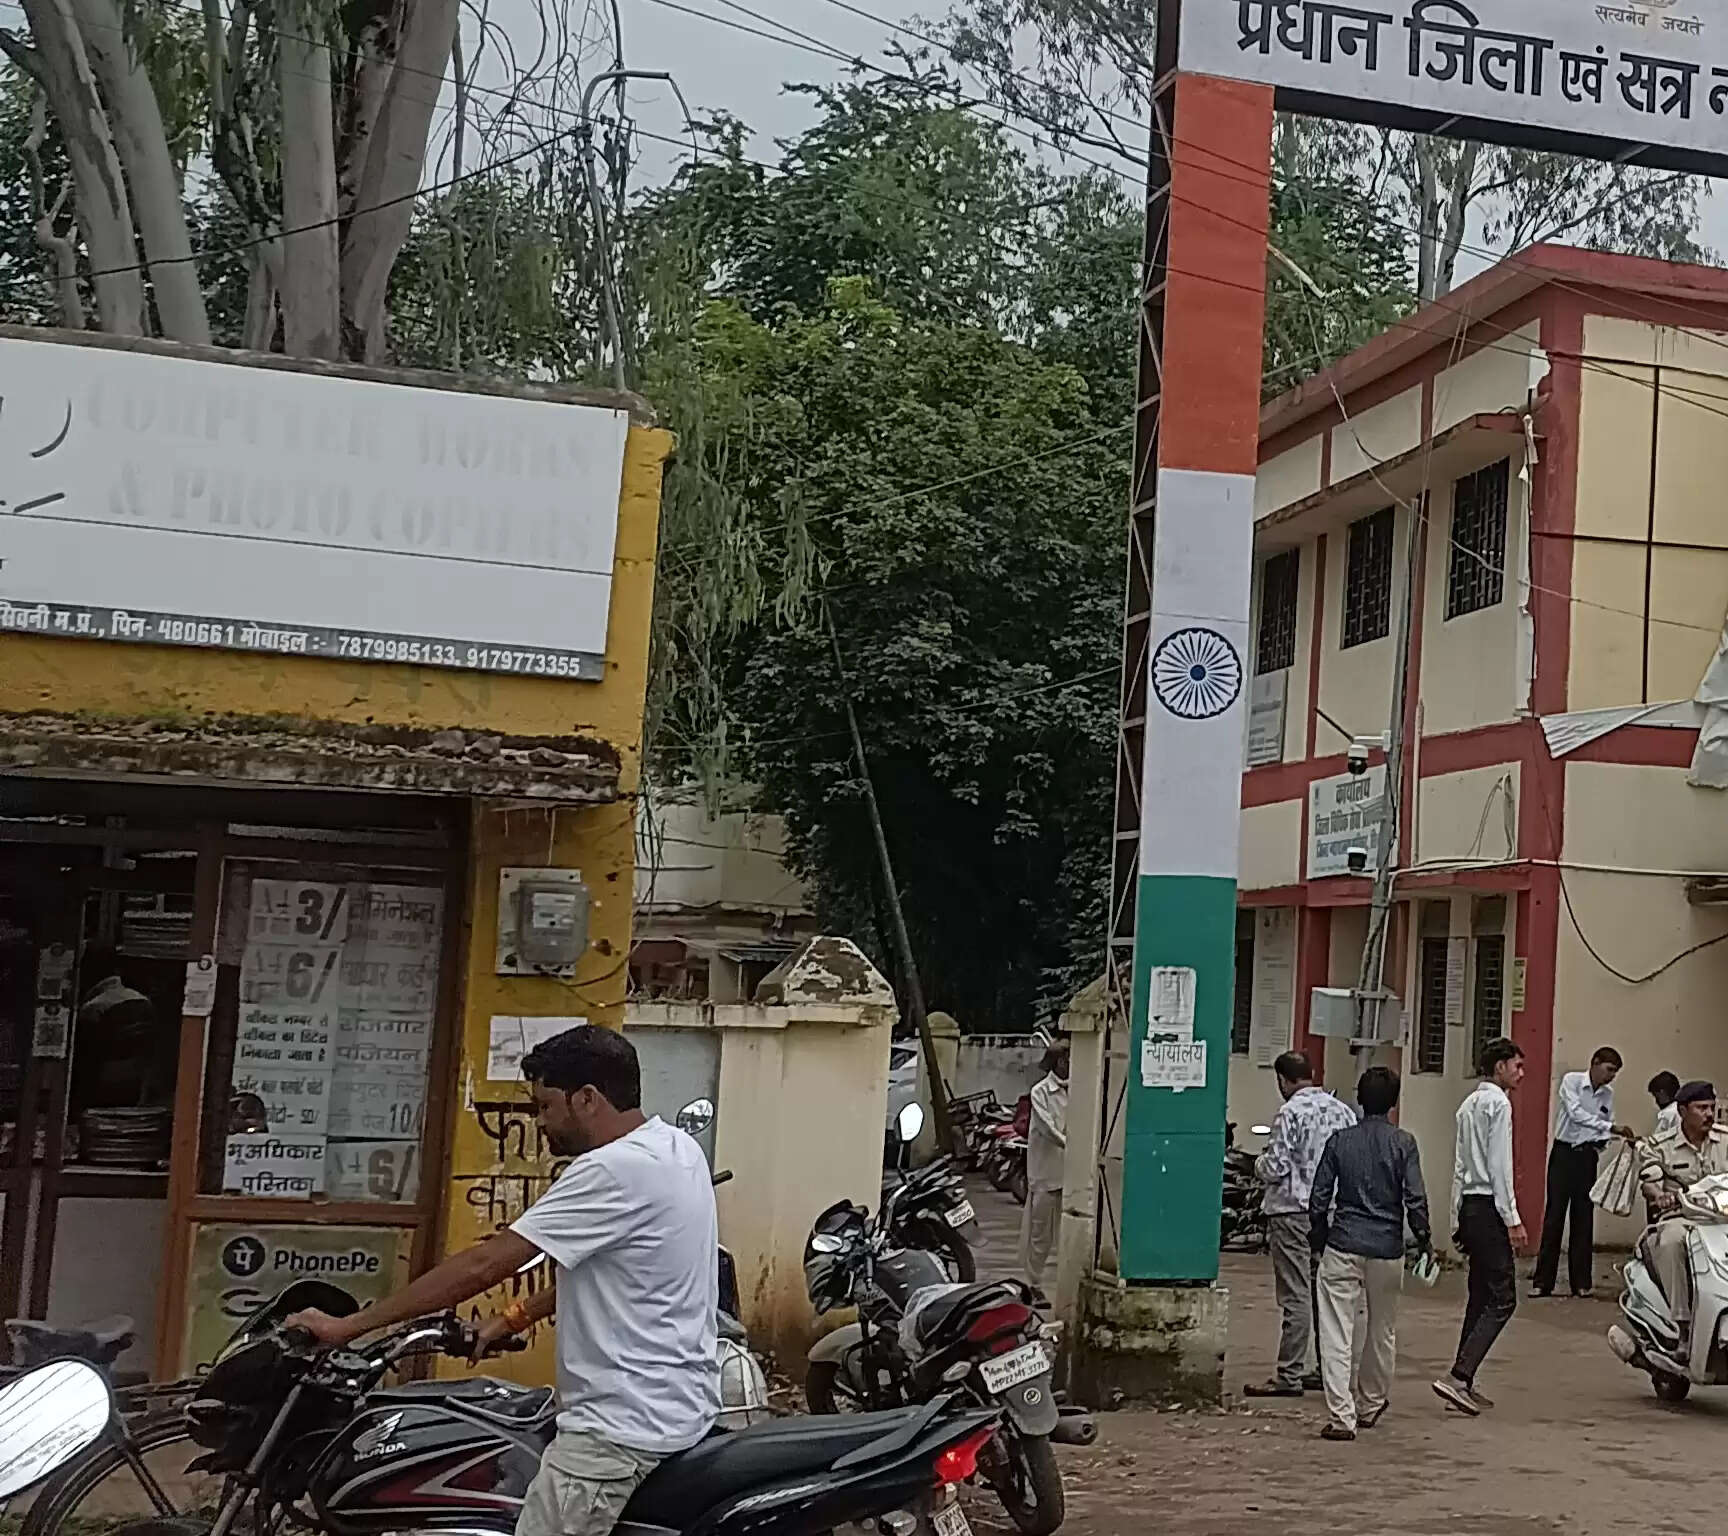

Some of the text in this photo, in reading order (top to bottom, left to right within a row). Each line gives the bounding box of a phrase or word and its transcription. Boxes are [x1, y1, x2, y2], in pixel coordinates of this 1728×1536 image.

[1560, 45, 1608, 103] एवं
[1616, 52, 1700, 119] सत्र
[158, 618, 234, 644] 480661
[240, 623, 308, 653] मोबाइल
[467, 647, 580, 676] 9179773355
[1145, 1043, 1204, 1064] न्यायालय
[273, 1250, 380, 1273] PhonePe
